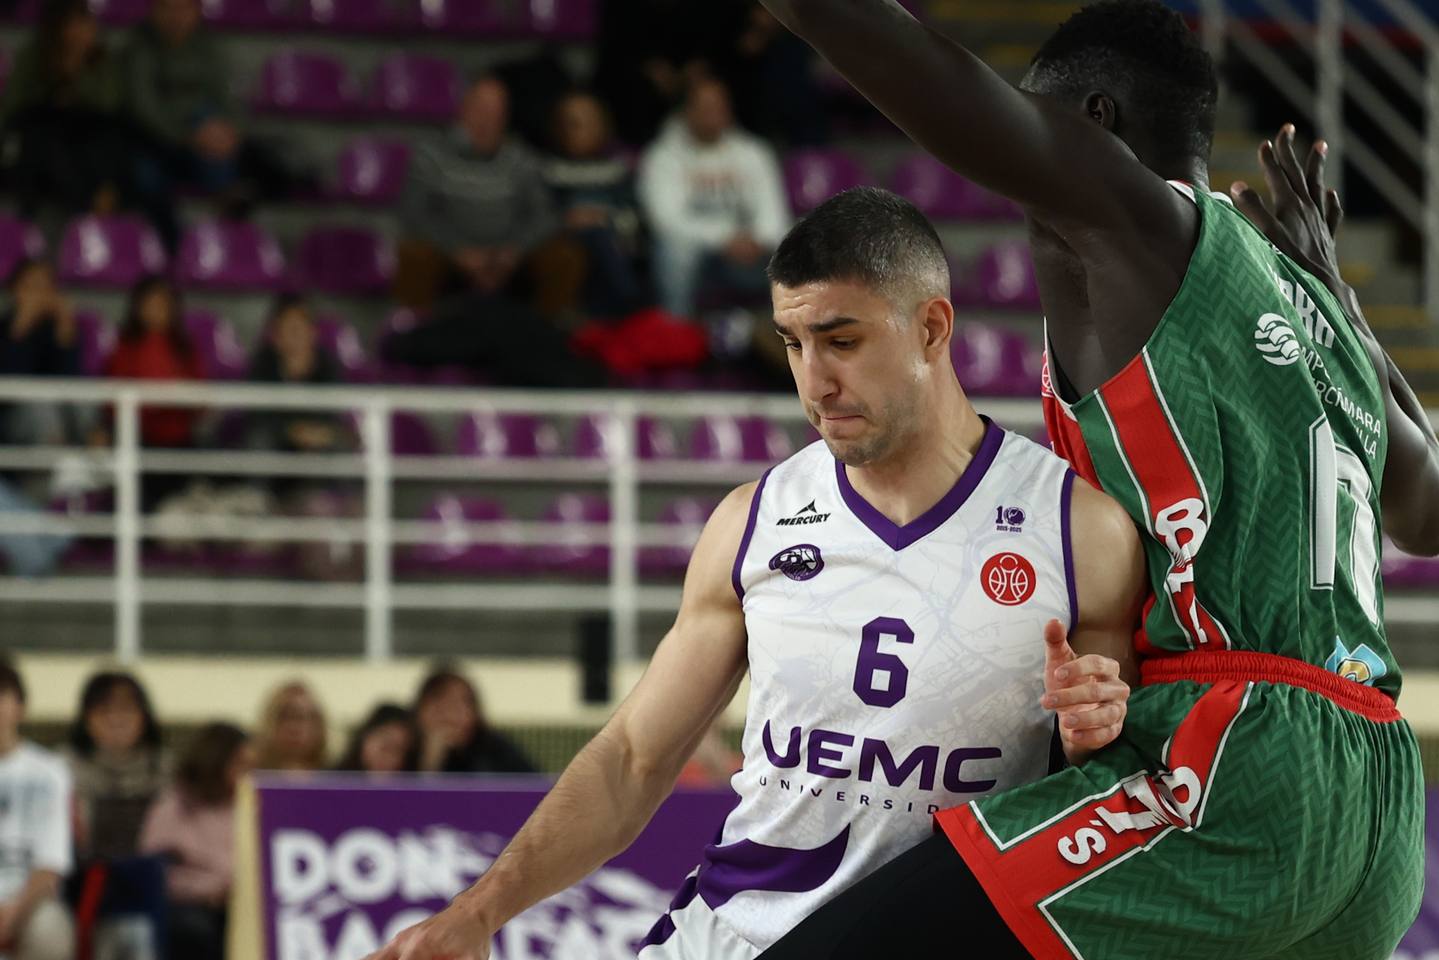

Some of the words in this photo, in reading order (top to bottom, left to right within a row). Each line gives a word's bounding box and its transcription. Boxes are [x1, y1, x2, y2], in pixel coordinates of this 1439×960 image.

[776, 513, 831, 526] MERCURY
[853, 616, 915, 707] 6
[762, 719, 1002, 793] UEMC
